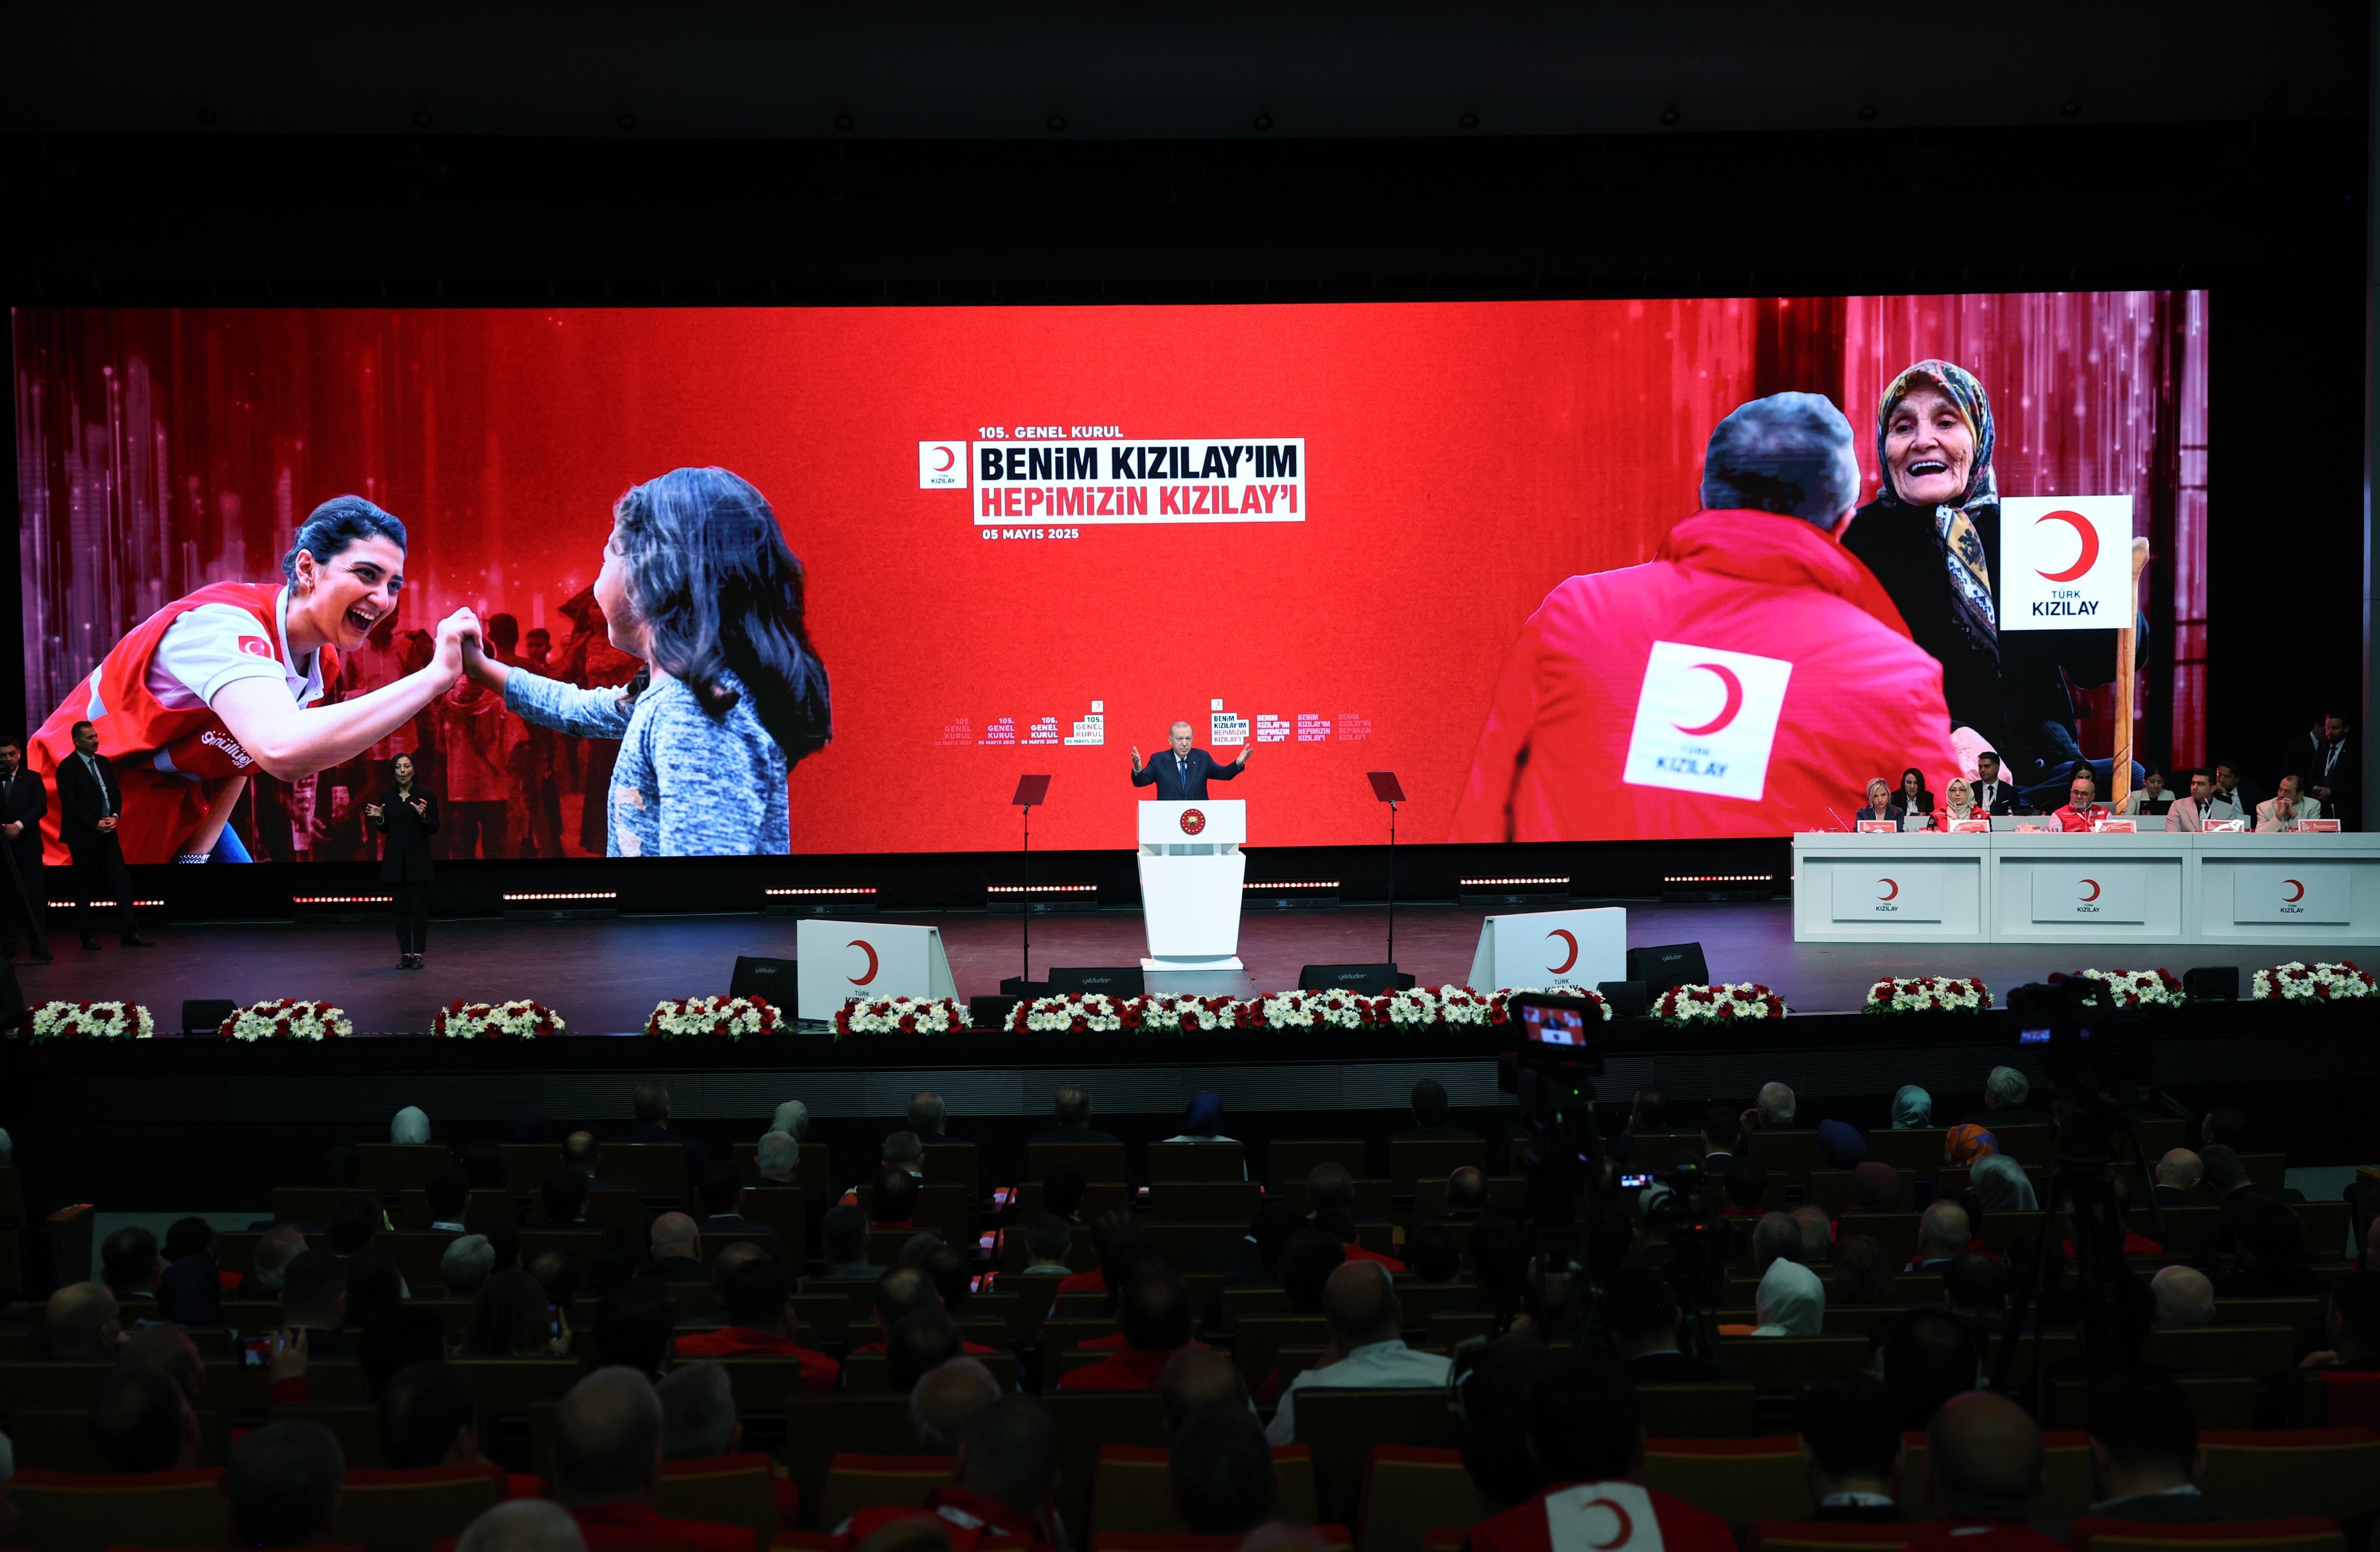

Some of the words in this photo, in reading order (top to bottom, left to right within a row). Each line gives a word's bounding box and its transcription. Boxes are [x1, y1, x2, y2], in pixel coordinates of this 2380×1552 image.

[978, 427, 1009, 439] 105.
[1014, 426, 1067, 438] GENEL
[1071, 426, 1124, 438] KURUL
[983, 529, 998, 539] 05
[1002, 529, 1044, 539] MAYIS
[1048, 528, 1079, 539] 2025
[2052, 589, 2081, 598] TÜRK
[2033, 601, 2099, 616] KIZILAY
